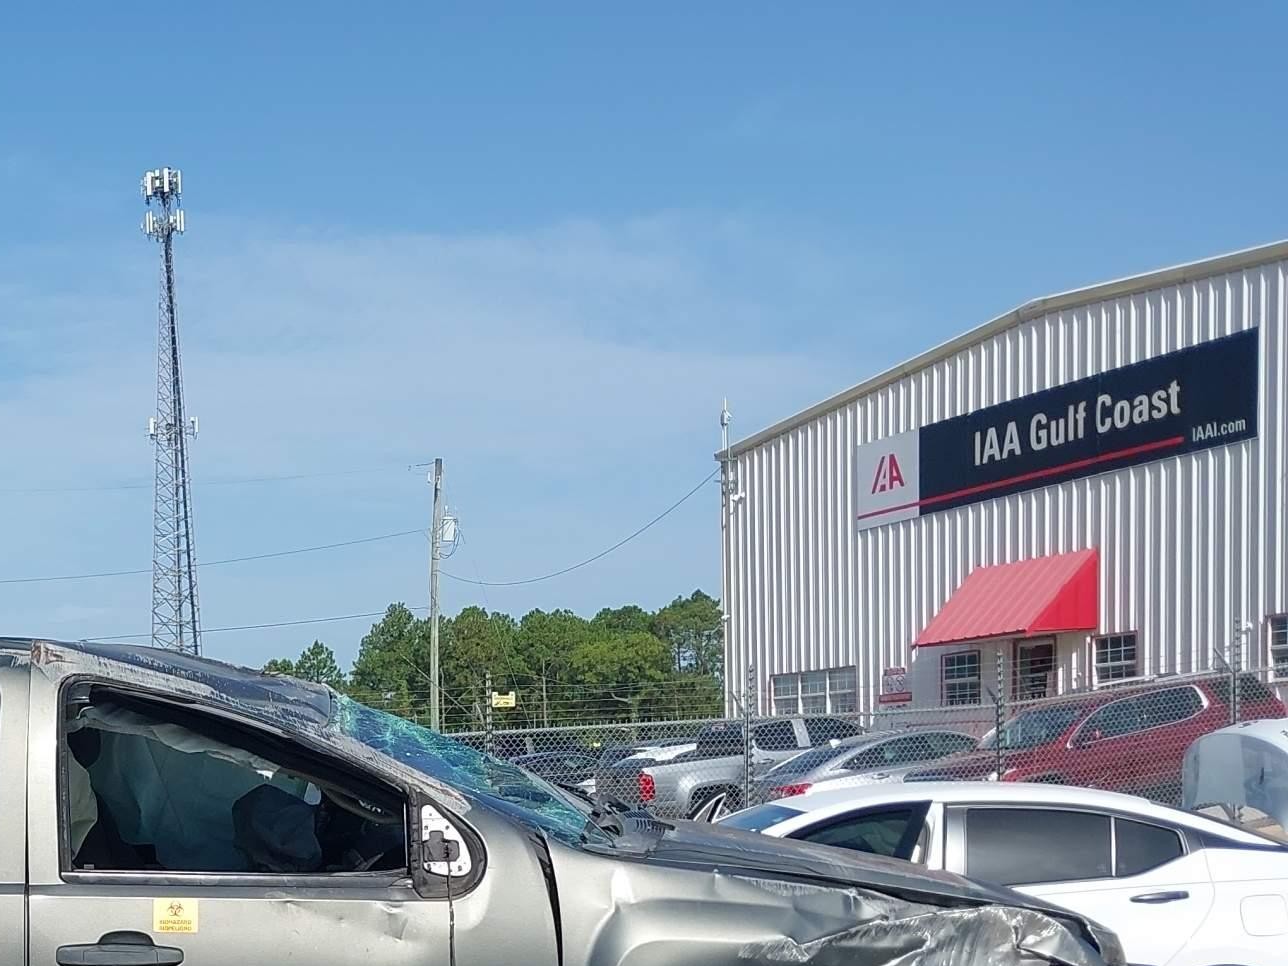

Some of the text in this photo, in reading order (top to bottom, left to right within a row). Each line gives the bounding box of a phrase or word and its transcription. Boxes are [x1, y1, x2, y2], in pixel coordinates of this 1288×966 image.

[974, 379, 1181, 466] IAA Gulf Coast
[1191, 418, 1246, 442] IAAI.com
